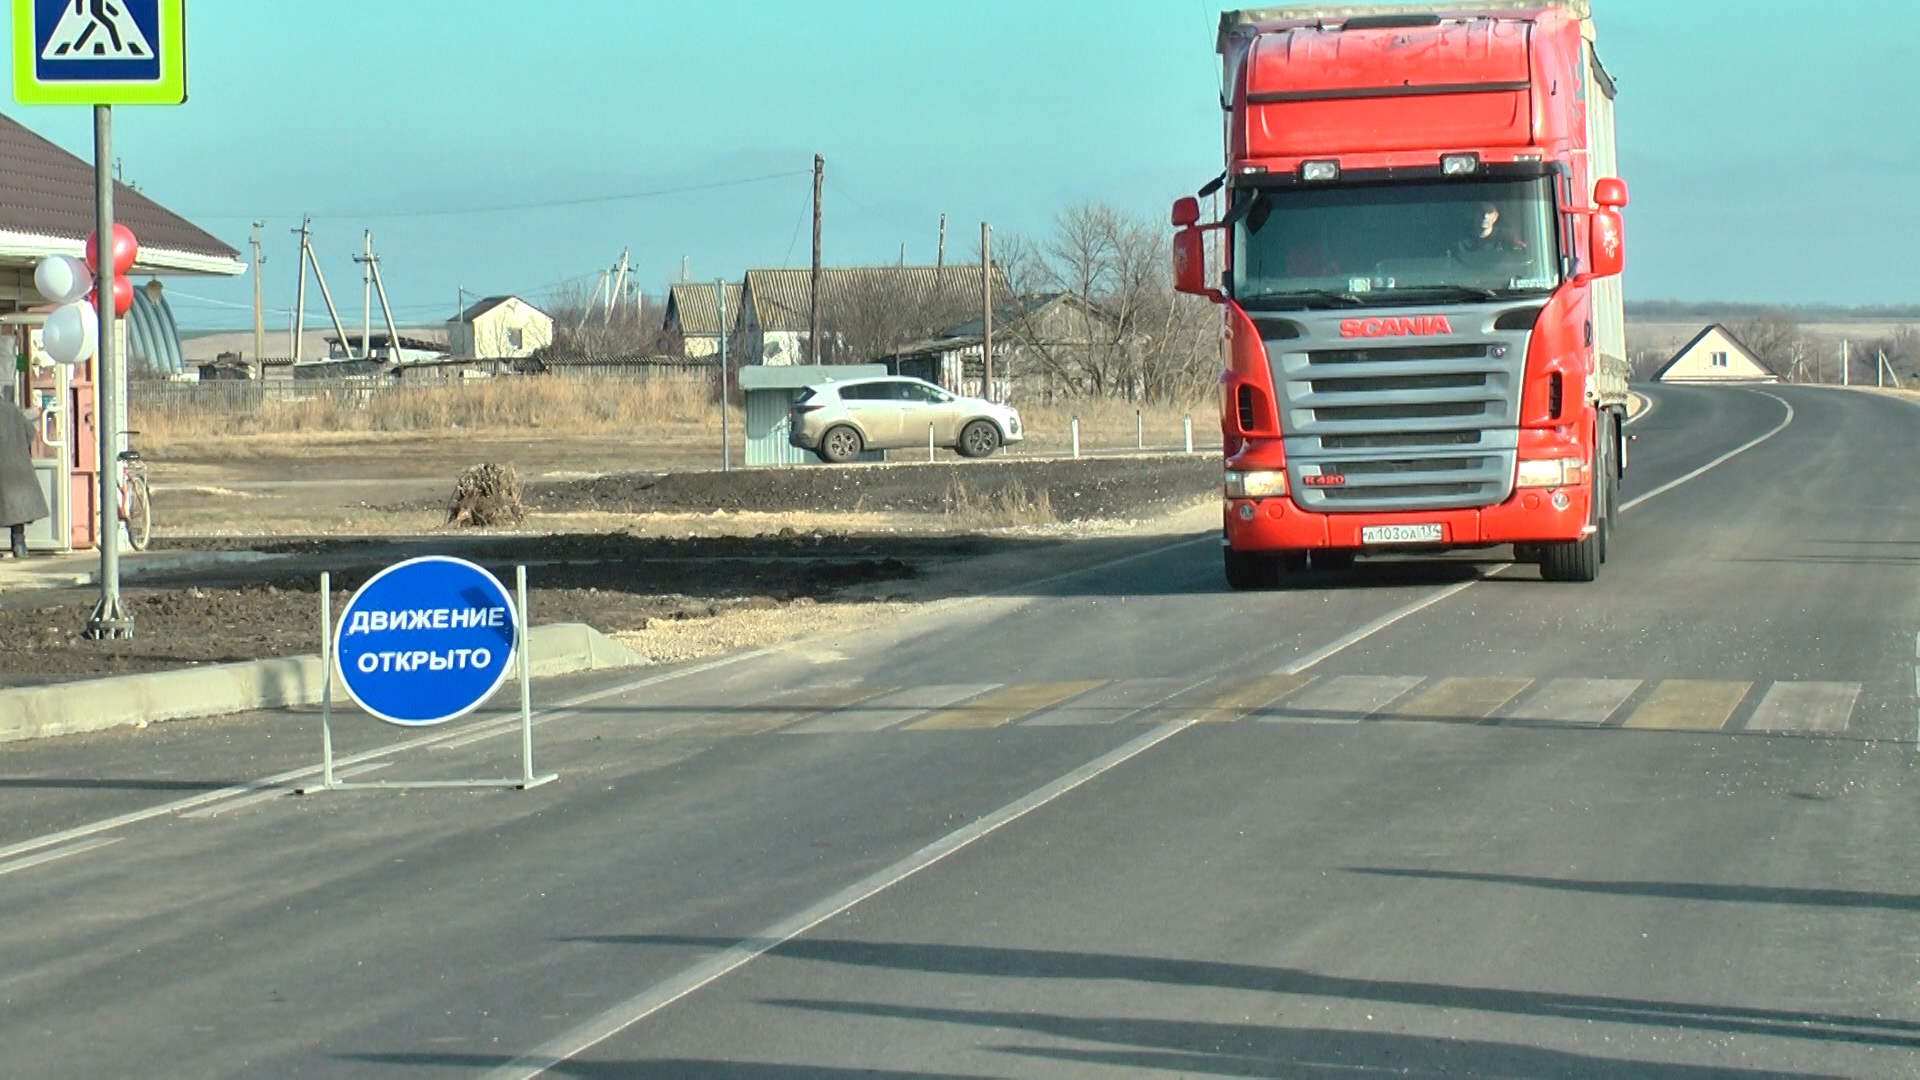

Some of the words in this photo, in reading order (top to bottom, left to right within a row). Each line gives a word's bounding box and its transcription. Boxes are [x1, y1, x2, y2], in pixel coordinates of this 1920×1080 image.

[1340, 315, 1452, 338] SCANIA
[348, 607, 506, 635] ДВИЖЕНИЕ
[357, 647, 492, 673] ОТКРЫТО
